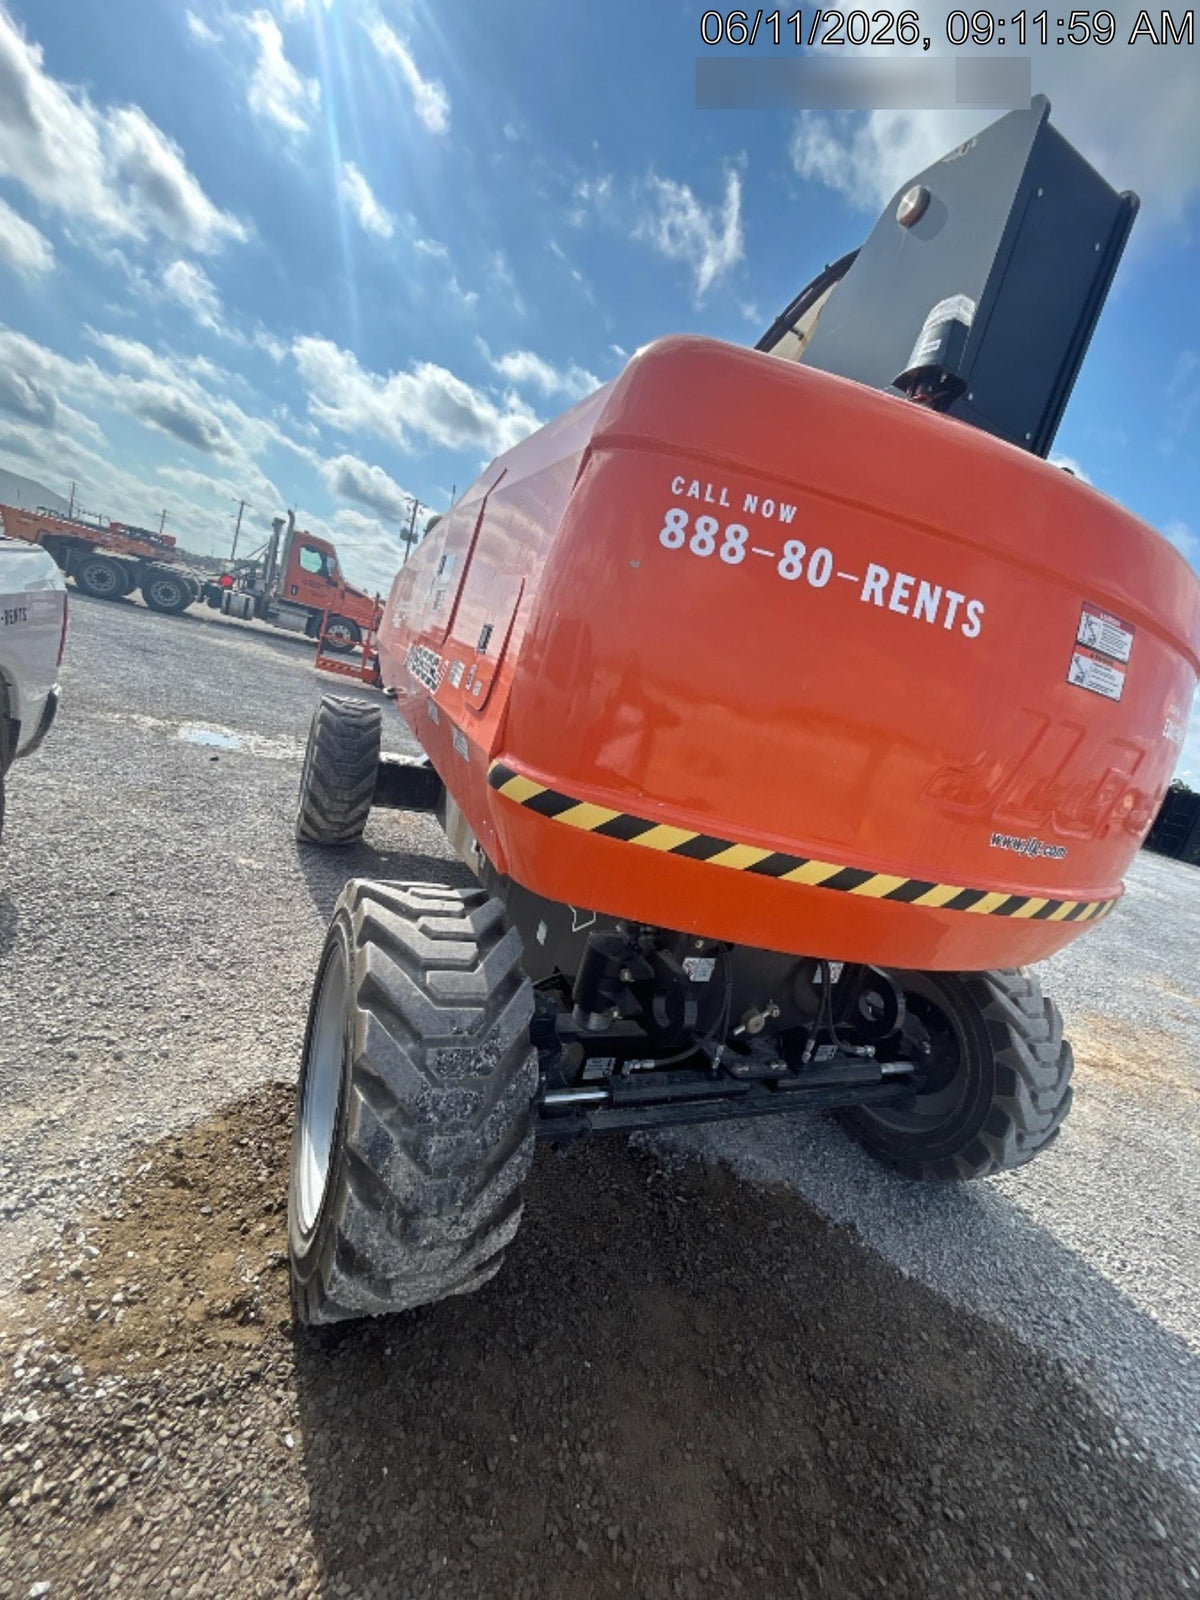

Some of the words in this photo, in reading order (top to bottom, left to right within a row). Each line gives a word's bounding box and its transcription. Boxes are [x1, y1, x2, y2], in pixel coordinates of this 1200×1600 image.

[671, 476, 730, 507] CALL
[743, 494, 797, 523] NOW
[658, 507, 985, 638] 888-80-RENTS
